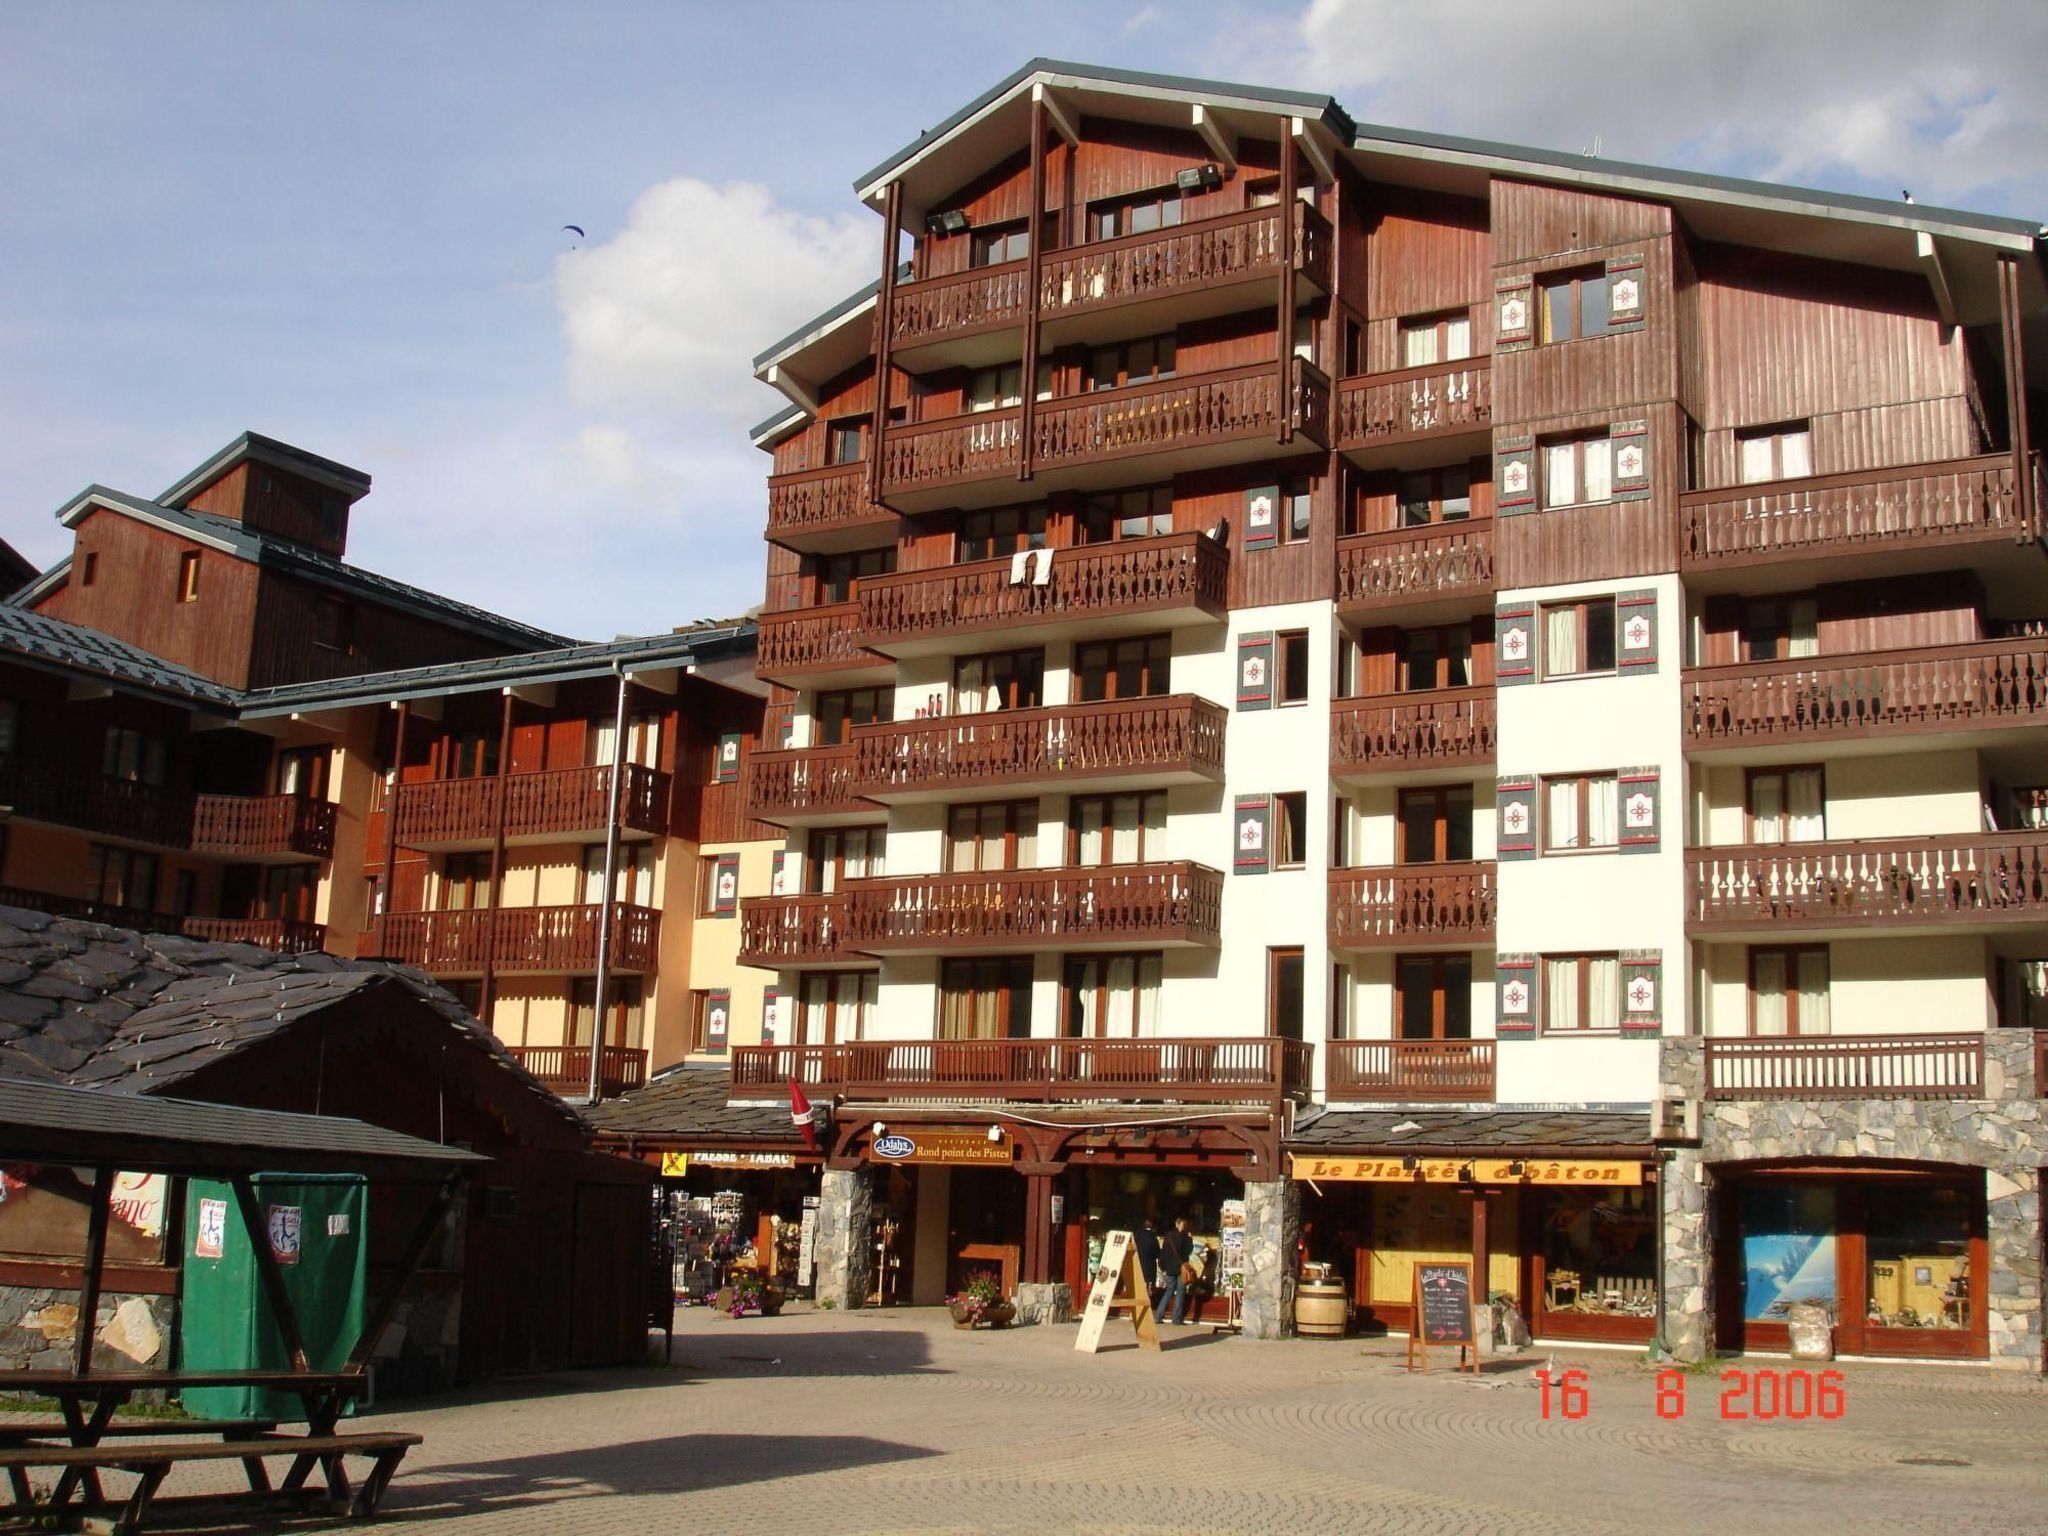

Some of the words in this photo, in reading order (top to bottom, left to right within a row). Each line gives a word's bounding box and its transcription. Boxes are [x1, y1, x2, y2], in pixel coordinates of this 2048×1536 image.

[881, 1139, 908, 1151] Odalys
[917, 1147, 940, 1157] Rond
[941, 1148, 964, 1160] point
[966, 1147, 981, 1158] des
[984, 1147, 1009, 1159] Pistes
[1311, 1161, 1343, 1178] Le
[1353, 1162, 1456, 1179] Platé
